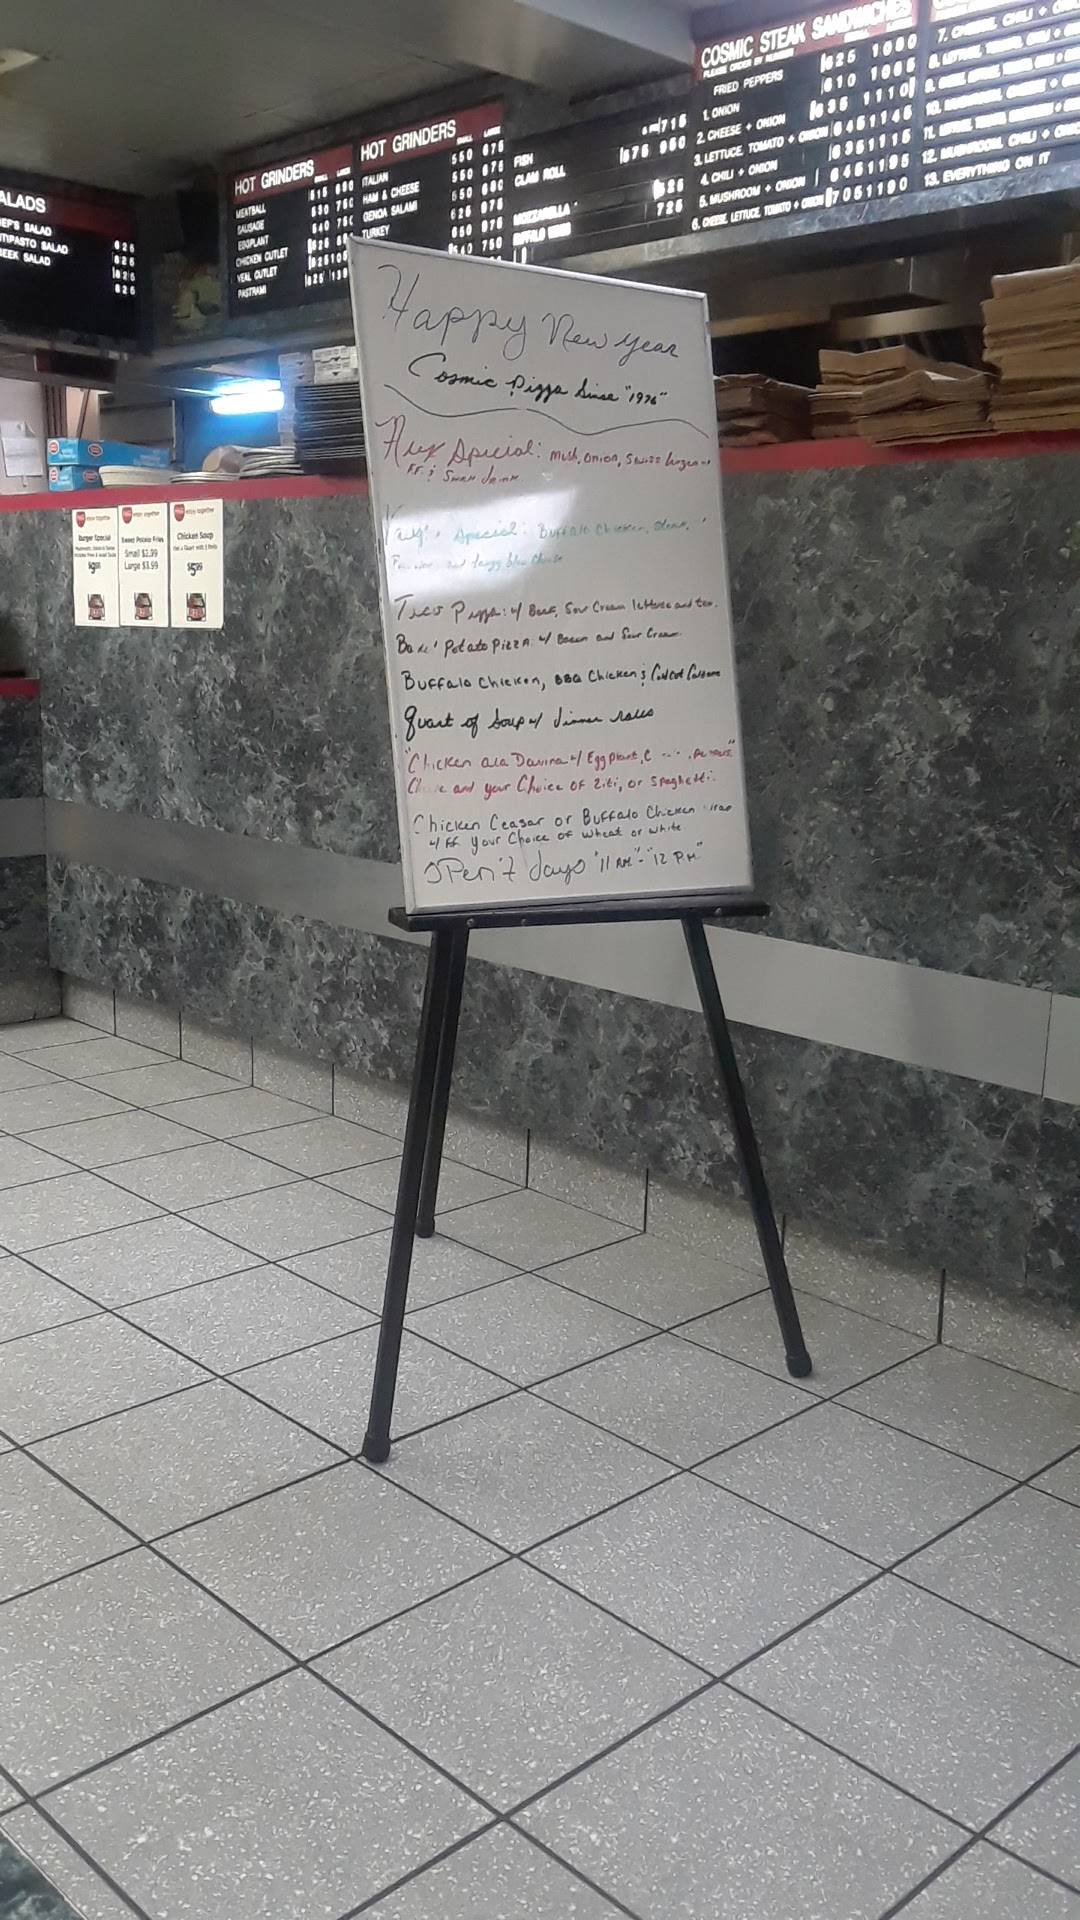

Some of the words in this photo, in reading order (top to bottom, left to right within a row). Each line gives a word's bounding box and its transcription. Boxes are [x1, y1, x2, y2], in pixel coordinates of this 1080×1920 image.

[702, 35, 753, 68] COSMIC
[760, 21, 806, 53] STEAK
[713, 80, 740, 96] FRIED
[743, 69, 784, 89] PEPPERS
[711, 102, 740, 118] ONION
[707, 123, 742, 141] CHEESE
[756, 113, 786, 130] ONION
[361, 140, 386, 161] HOT
[392, 120, 456, 153] GRINDERS
[748, 136, 784, 154] TOMATO
[514, 153, 533, 168] FISH
[943, 159, 1010, 183] EVERYTHING
[1015, 155, 1034, 170] ON
[1039, 151, 1051, 165] IT
[235, 176, 256, 196] HOT
[261, 159, 314, 189] GRINDERS
[362, 172, 389, 188] ITALIAN
[515, 170, 539, 187] CLAM
[543, 165, 566, 181] ROLL
[711, 168, 734, 183] CHILI
[391, 181, 420, 198] CHEESE
[710, 185, 761, 205] MUSHROOM
[0, 190, 46, 213] ALADS
[391, 200, 418, 216] SALAMI
[236, 203, 266, 219] MEATBALL
[24, 222, 52, 236] SALAD
[362, 224, 390, 239] TURKEY
[41, 240, 68, 255] SALAD
[264, 247, 288, 262] CUTLET
[23, 252, 51, 266] SALAD
[254, 266, 278, 280] CUTLET
[238, 284, 267, 299] PASTRAMI
[377, 264, 528, 361] Happy
[541, 312, 607, 353] New
[408, 352, 497, 388] Cosmic
[177, 532, 198, 540] Chicken
[200, 531, 214, 540] Soup
[124, 549, 140, 558] Small
[124, 561, 140, 571] Large
[401, 670, 472, 690] Buffalo
[555, 674, 582, 685] BBQ
[588, 669, 637, 683] Chicken
[461, 712, 479, 739] of
[453, 781, 475, 794] and
[485, 783, 511, 801] your
[627, 779, 643, 789] or
[490, 813, 545, 831] Ceasar
[554, 815, 572, 827] or
[583, 808, 638, 826] Buffalo
[646, 805, 695, 819] Chicken
[631, 829, 643, 837] or
